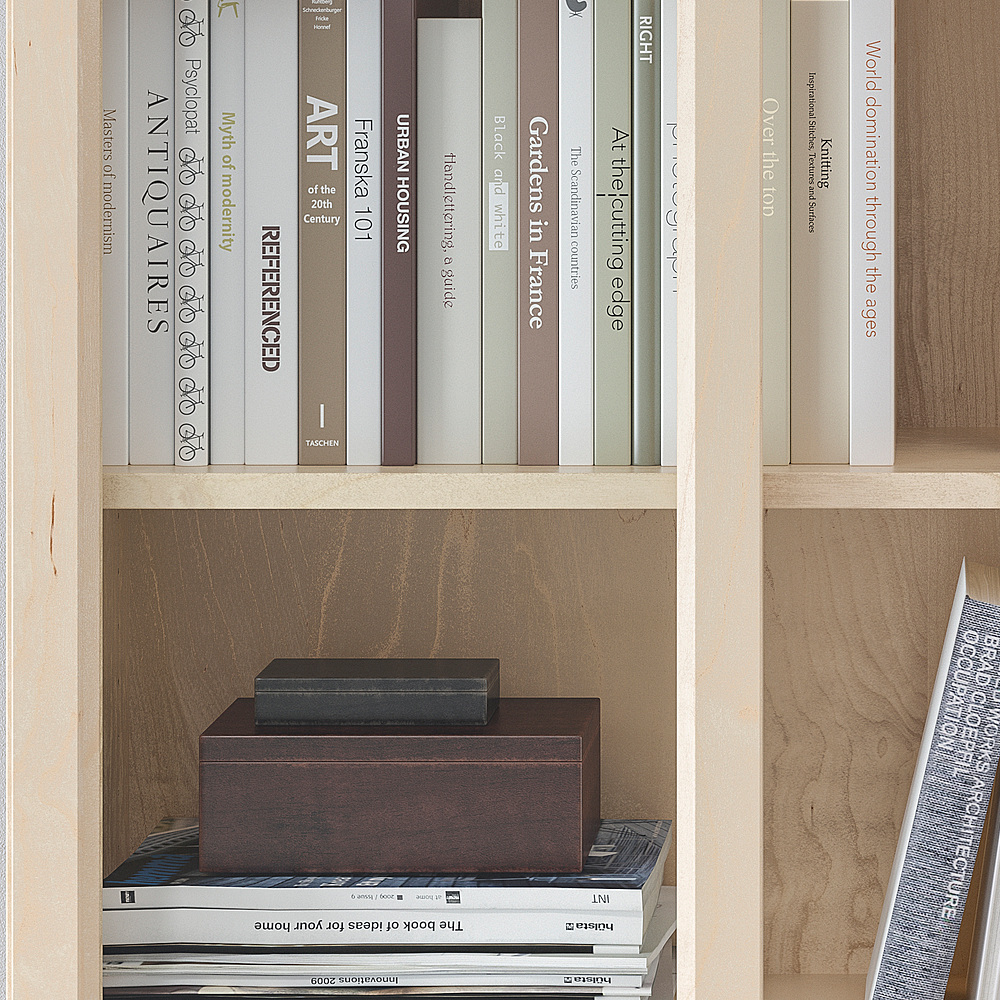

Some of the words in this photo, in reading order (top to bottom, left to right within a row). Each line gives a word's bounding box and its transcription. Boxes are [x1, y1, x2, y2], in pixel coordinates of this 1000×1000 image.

[639, 16, 652, 63] RIGHT
[866, 41, 882, 92] World
[182, 59, 201, 134] Psyclopat
[806, 72, 816, 119] Inspirational
[102, 109, 117, 160] Masters
[219, 112, 235, 145] Myth
[306, 96, 338, 170] ART
[494, 116, 505, 160] Black
[611, 127, 629, 152] At
[763, 98, 779, 149] Over
[807, 121, 816, 151] Stitches,
[221, 155, 235, 169] of
[354, 119, 373, 198] Franska
[396, 114, 409, 173] URBAN
[570, 146, 581, 166] The
[866, 97, 882, 191] domination
[102, 164, 117, 179] of
[494, 169, 505, 195] and
[528, 116, 549, 213] Gardens
[611, 157, 629, 190] the
[763, 152, 779, 181] the
[808, 153, 816, 184] Textures
[818, 138, 833, 189] Knitting
[308, 186, 317, 194] of
[319, 186, 336, 194] the
[311, 200, 333, 209] 20th
[442, 152, 456, 253] Handlettering,
[570, 169, 582, 238] Scandinavian
[808, 186, 816, 200] and
[102, 183, 117, 255] modernism
[142, 90, 169, 334] ANTIQUAIRES
[219, 174, 235, 252] modernity
[303, 214, 340, 224] Century
[354, 206, 373, 242] 101
[396, 177, 409, 253] HOUSING
[494, 203, 505, 249] white
[808, 202, 816, 233] Surfaces
[862, 197, 882, 261] through
[529, 220, 549, 242] in
[607, 198, 629, 271] cutting
[443, 257, 454, 265] a
[570, 241, 581, 289] countries
[442, 269, 456, 308] guide
[529, 249, 549, 329] France
[866, 267, 882, 293] the
[261, 226, 280, 372] REFERENCED
[607, 277, 629, 331] edge
[862, 299, 879, 338] ages
[973, 634, 1000, 687] BRAD
[938, 629, 980, 750] OCCUPATION
[941, 777, 985, 919] ARCHITECTURE
[591, 894, 609, 904] INT
[254, 922, 291, 932] home
[294, 920, 323, 931] your
[326, 922, 345, 932] for
[348, 922, 382, 932] ideas
[386, 921, 399, 932] of
[404, 921, 435, 932] book
[440, 921, 462, 932] The
[576, 922, 613, 931] hülsta
[311, 977, 335, 985] 2009
[338, 976, 398, 985] Innovations
[574, 976, 611, 984] hülsta
